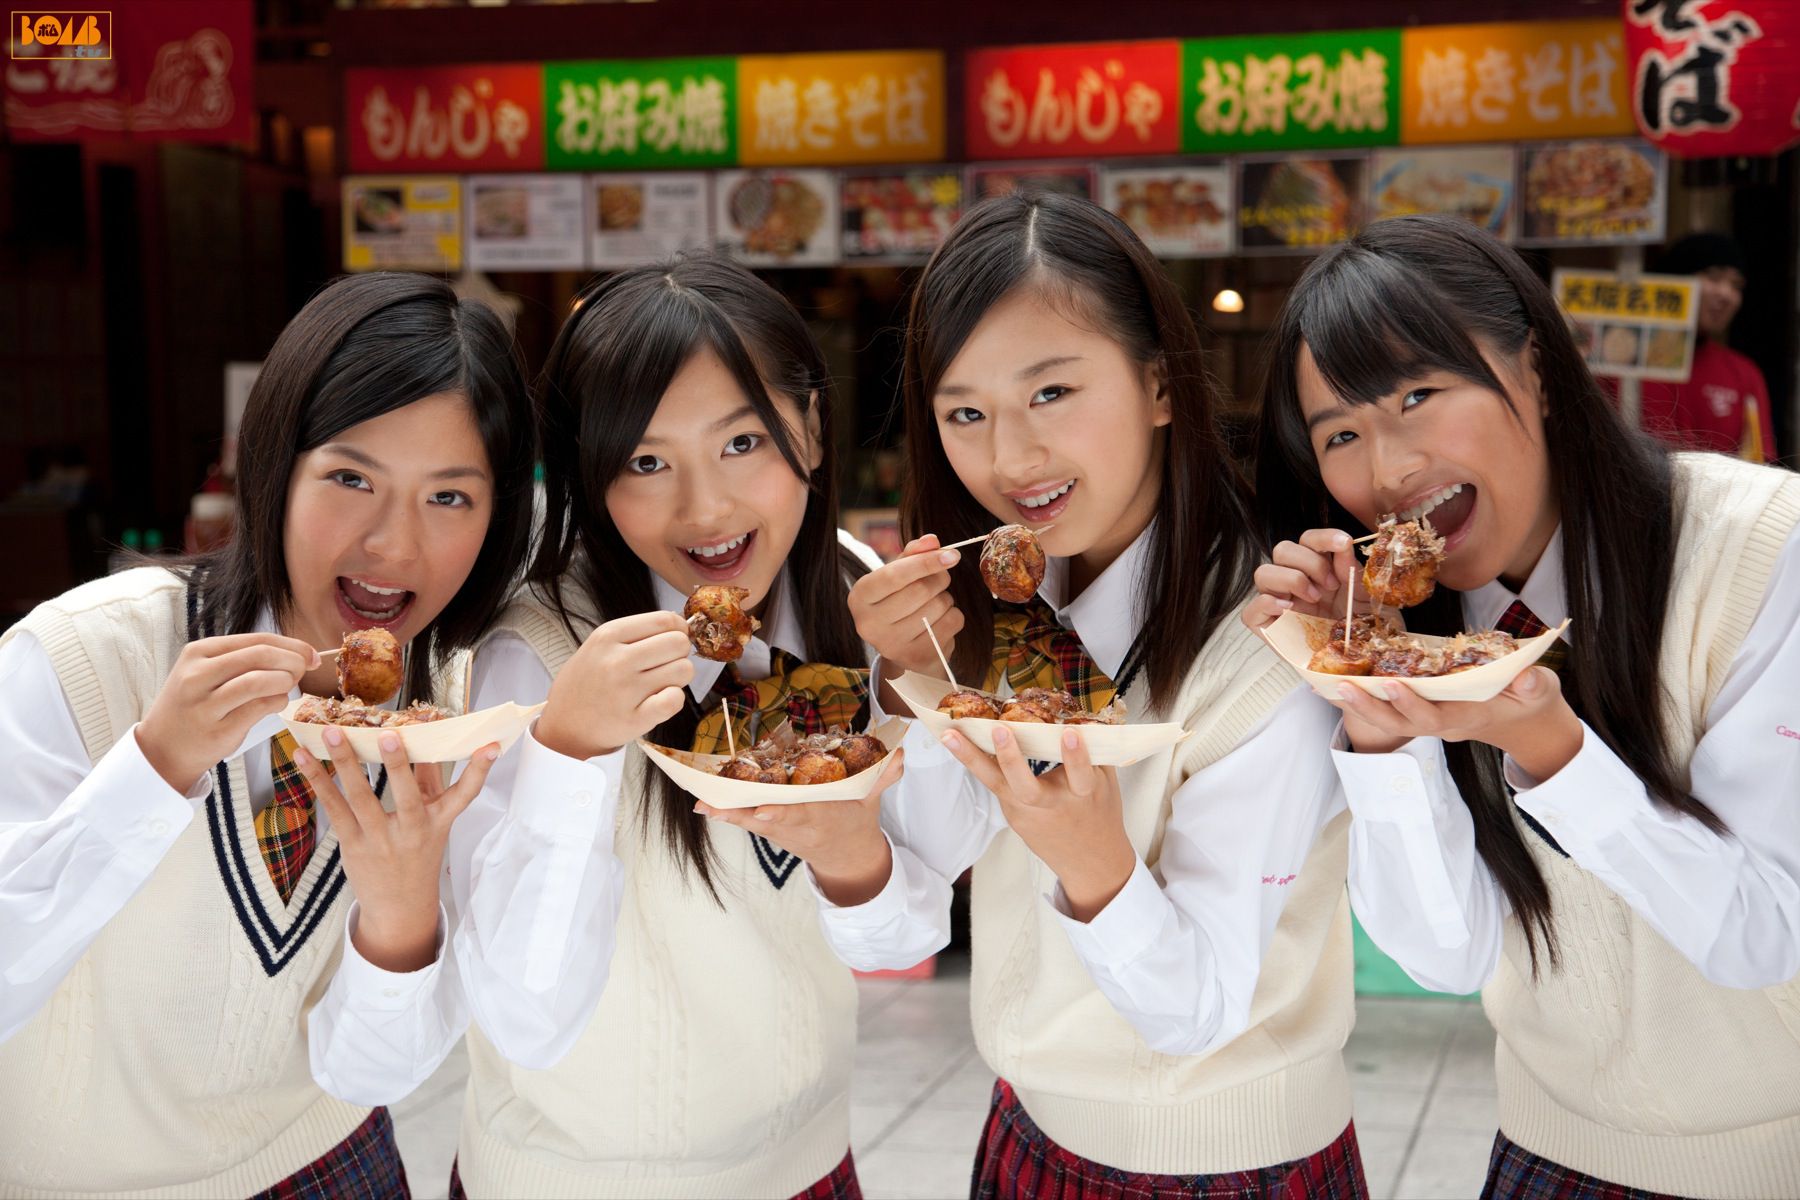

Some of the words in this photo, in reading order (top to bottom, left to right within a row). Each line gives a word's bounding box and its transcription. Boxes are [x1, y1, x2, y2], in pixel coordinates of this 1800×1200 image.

[363, 79, 529, 158] もんじゃ
[556, 77, 727, 153] お好み焼
[754, 68, 929, 151] 焼きそば
[981, 60, 1163, 147] もんじゃ
[1196, 47, 1389, 134] お好み焼
[1418, 34, 1622, 127] 焼きそば
